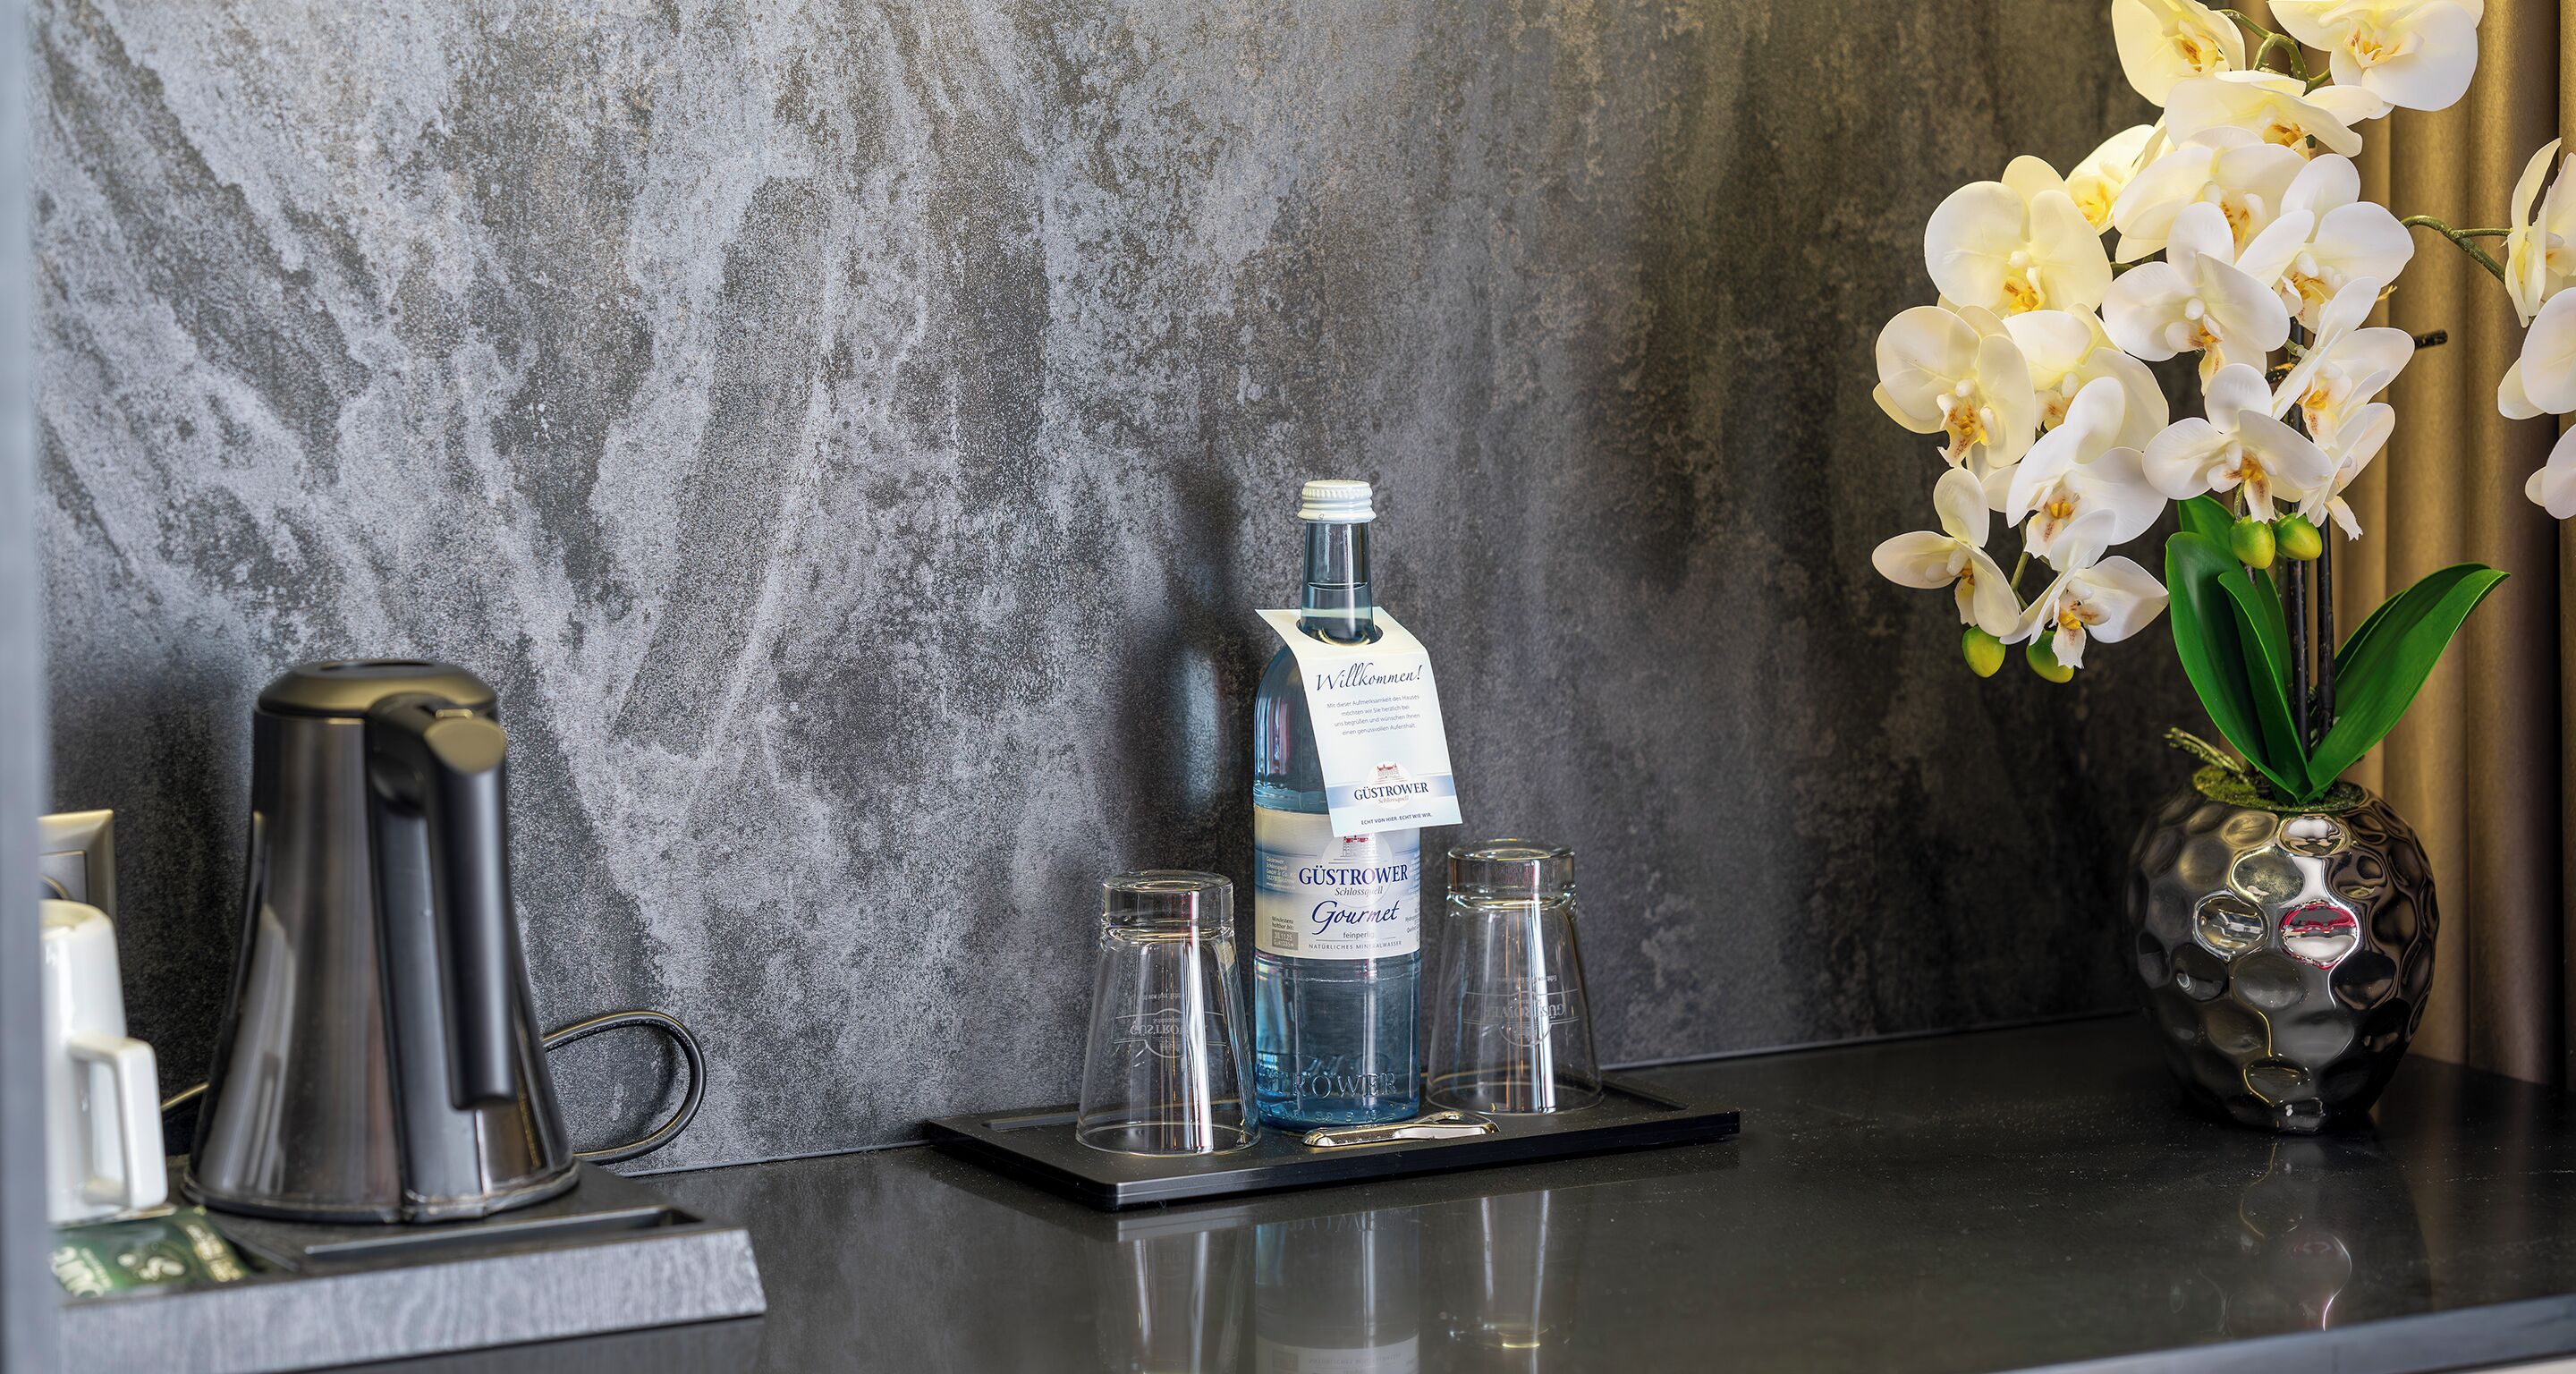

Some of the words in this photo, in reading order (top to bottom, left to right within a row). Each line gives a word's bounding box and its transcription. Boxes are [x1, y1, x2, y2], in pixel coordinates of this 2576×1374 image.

[1317, 662, 1422, 691] Willkommen!
[1353, 782, 1429, 801] GÜSTROWER
[1299, 864, 1408, 886] GÜSTROWER
[1311, 900, 1400, 936] Gourmet
[1356, 940, 1402, 950] MINALWASSER
